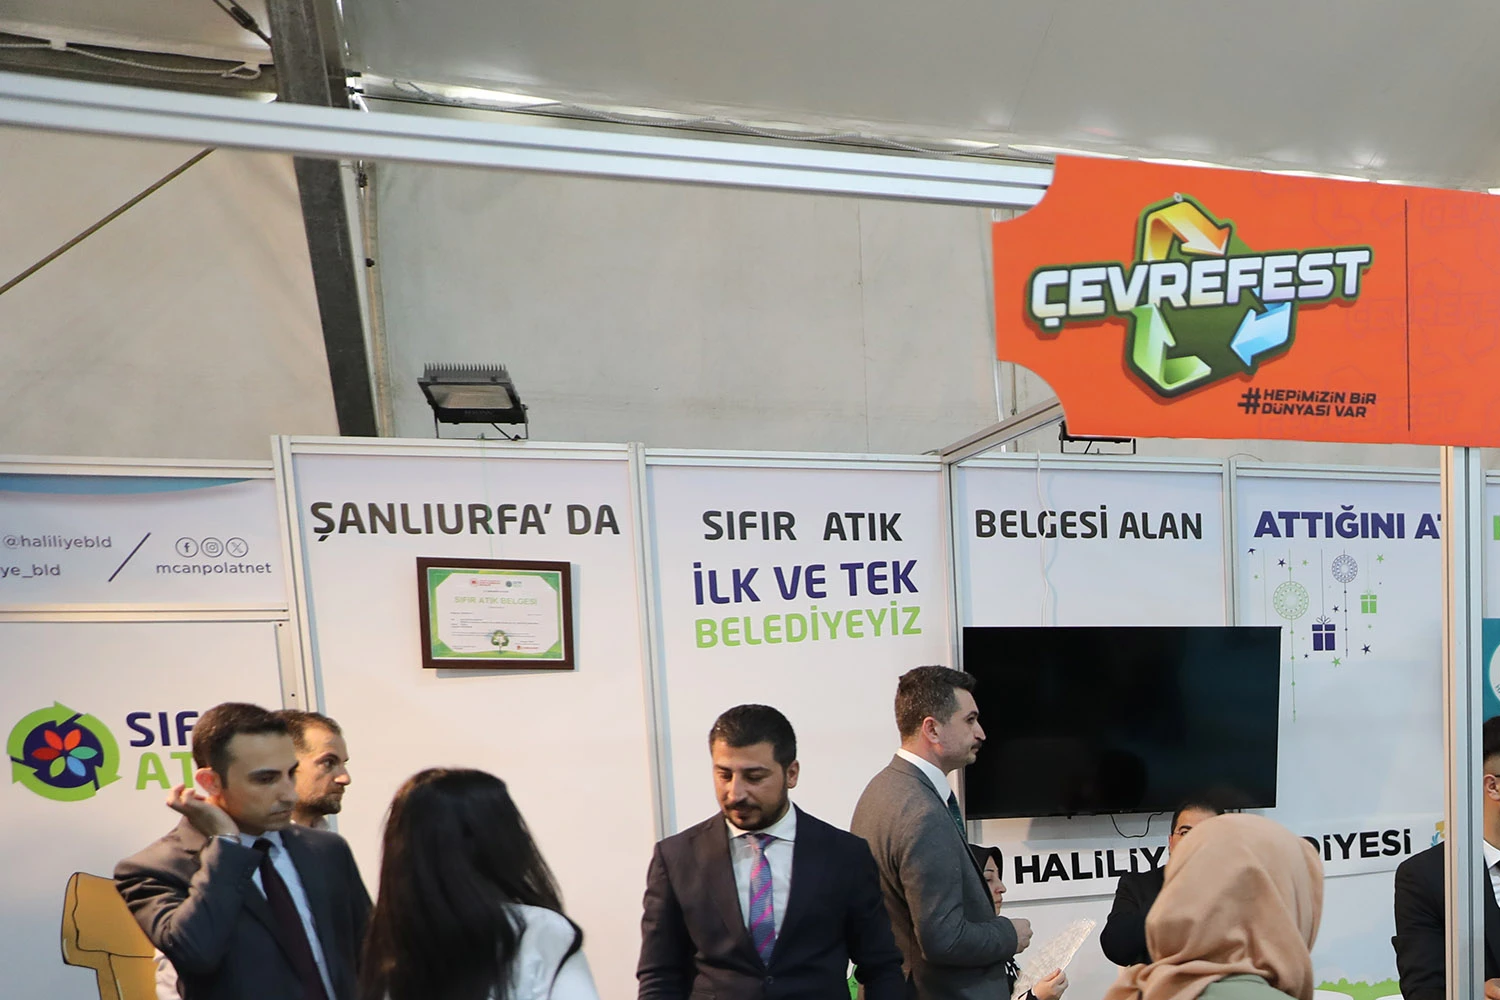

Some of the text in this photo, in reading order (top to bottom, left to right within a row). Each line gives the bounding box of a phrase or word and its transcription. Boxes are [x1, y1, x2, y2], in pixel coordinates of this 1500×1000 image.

[1031, 249, 1371, 328] ÇEVREFEST
[1261, 402, 1367, 418] DÜNYASI VAR
[567, 504, 621, 535] DA
[702, 511, 903, 541] SIFIR ATIK
[975, 504, 1202, 540] BELGESİ ALAN
[1253, 504, 1405, 540] ATTIĞINI
[3, 534, 112, 549] @haliliyebld
[156, 562, 272, 576] mcanpolatnet
[693, 560, 919, 606] İLK VE TEK
[695, 600, 922, 649] BELEDİYEYİZ
[126, 710, 199, 747] SIF
[136, 751, 194, 790] AT
[1014, 845, 1167, 884] HALİLİY
